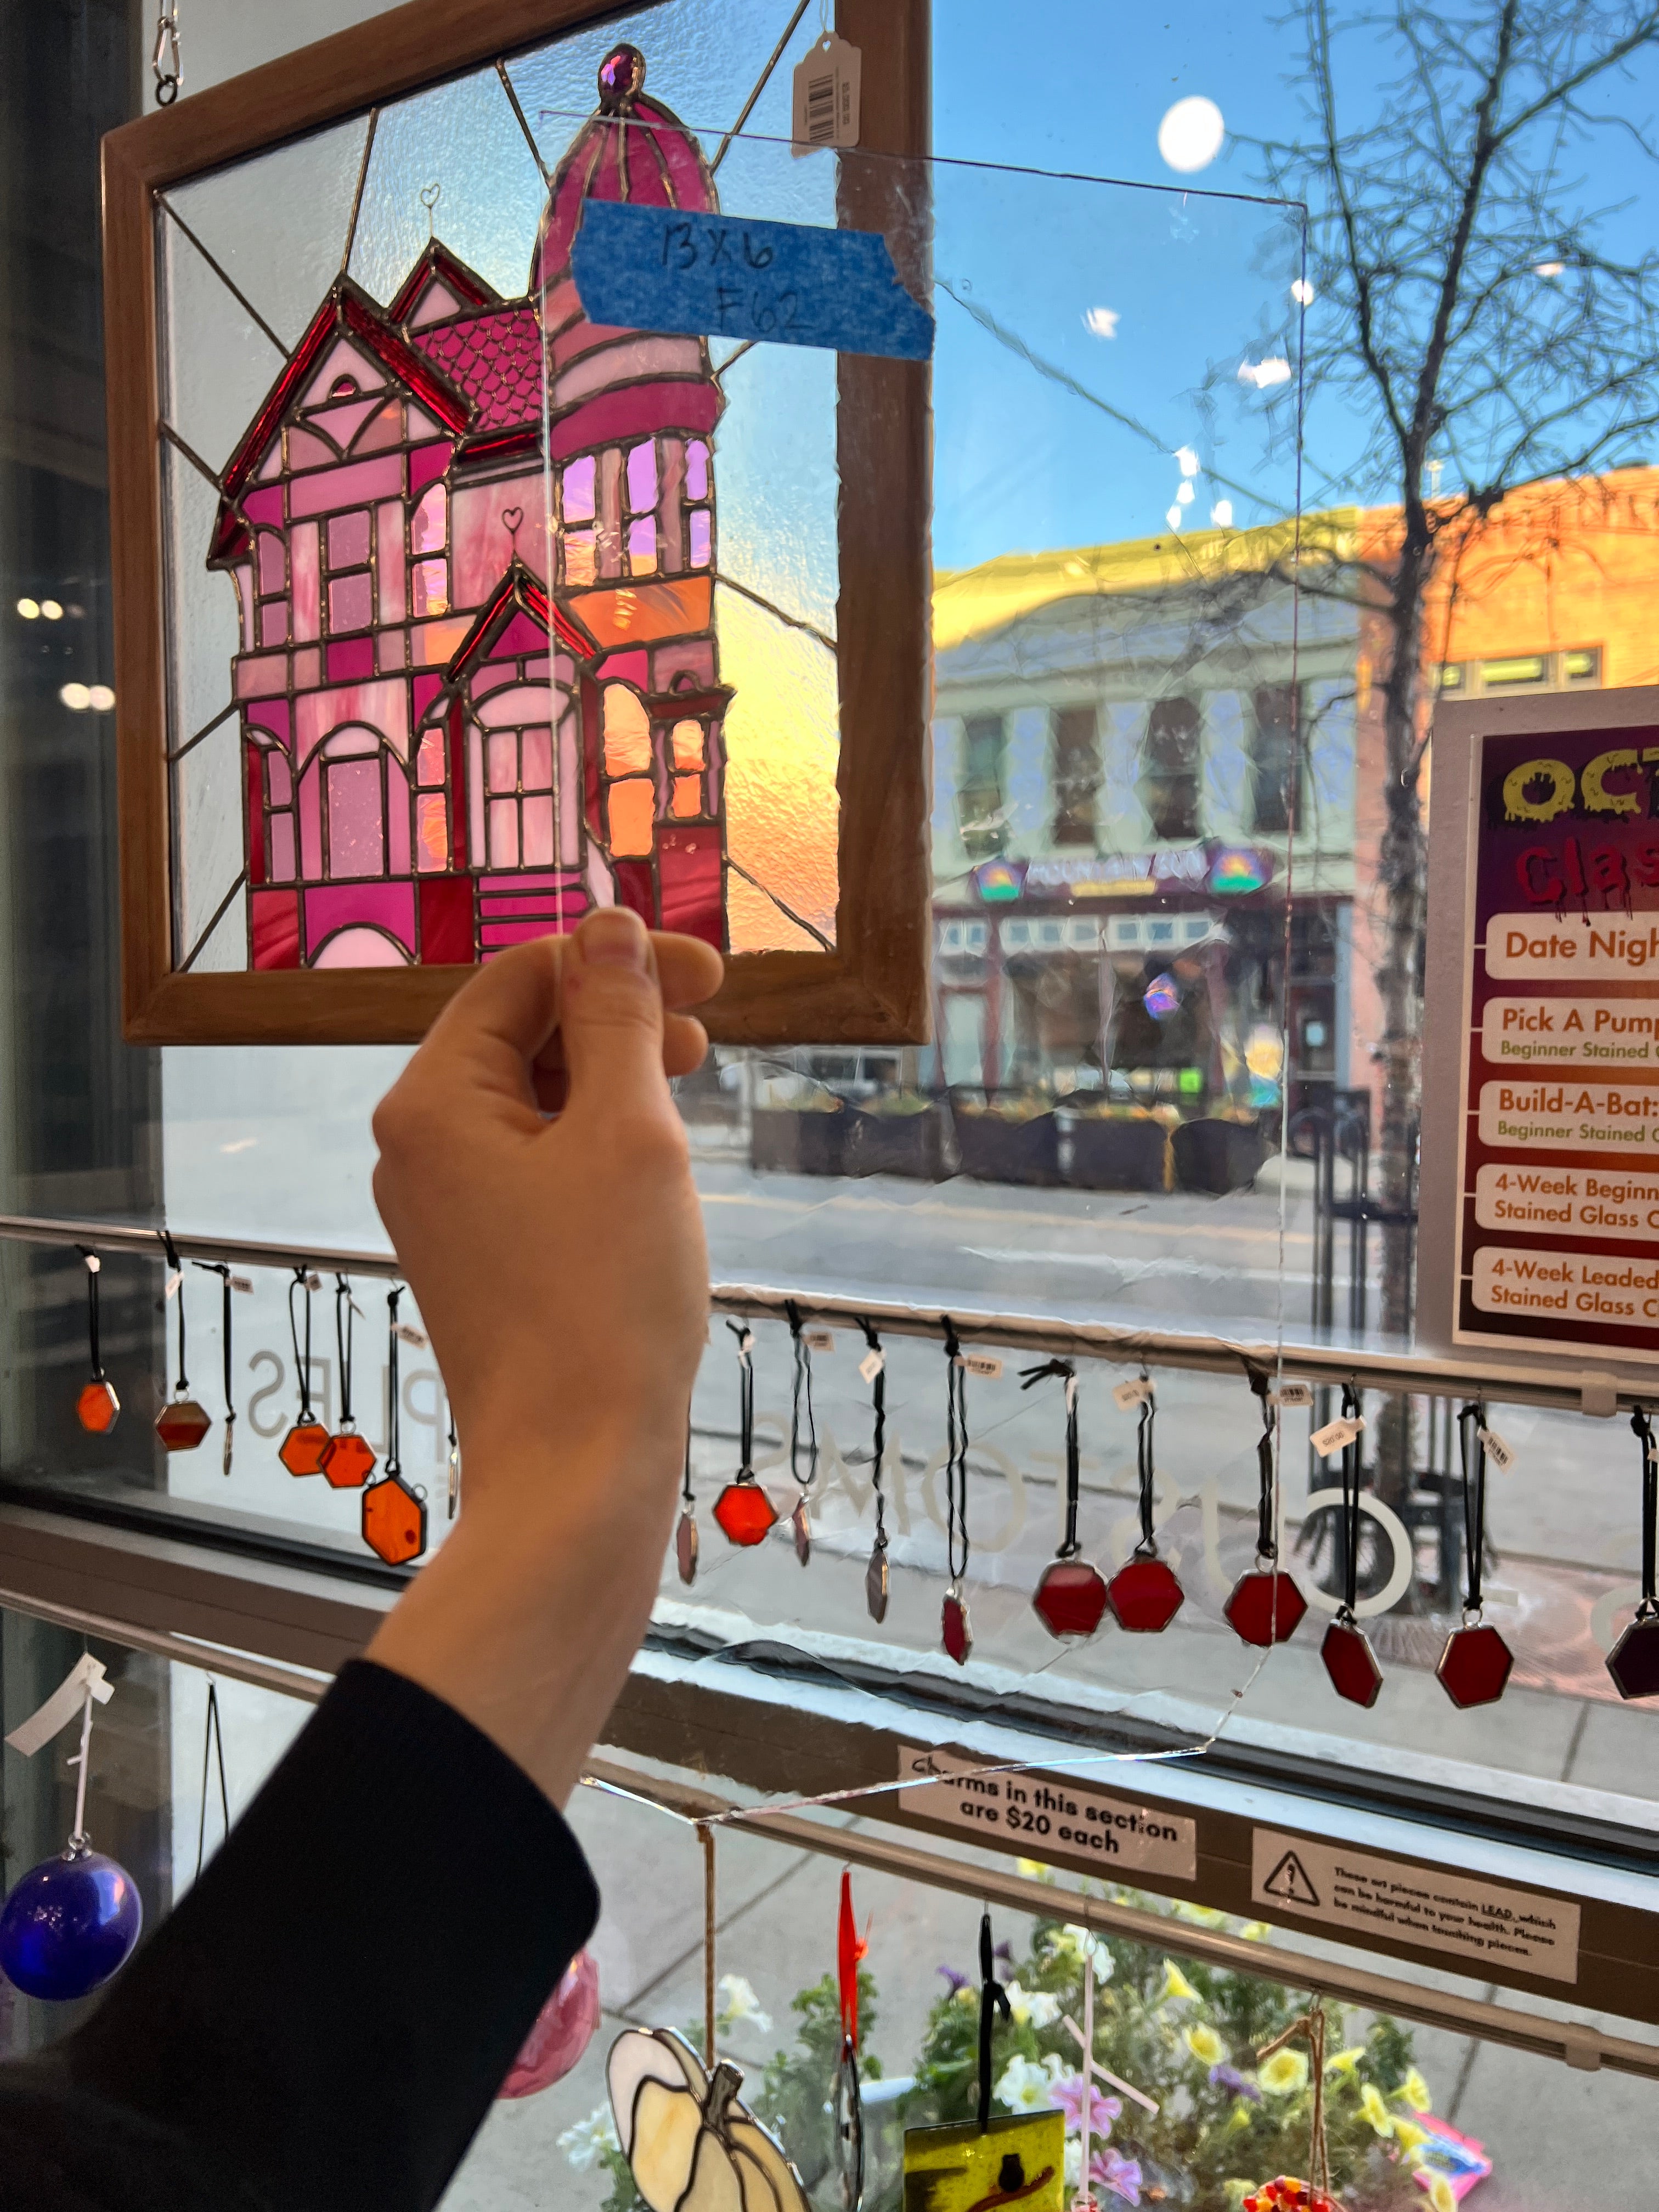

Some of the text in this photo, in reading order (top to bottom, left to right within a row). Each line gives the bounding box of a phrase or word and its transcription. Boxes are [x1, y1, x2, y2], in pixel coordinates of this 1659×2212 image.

[1506, 930, 1577, 959] Date
[1502, 1006, 1554, 1032] Pick
[1564, 1008, 1584, 1032] A
[1500, 1040, 1577, 1060] Beginner
[1583, 1041, 1650, 1058] Stained
[1499, 1087, 1658, 1118] Build-A-Bat:
[1498, 1120, 1573, 1141] Beginner
[1579, 1123, 1646, 1143] Stained
[1494, 1172, 1578, 1196] 4-Week
[1494, 1199, 1572, 1223] Stained
[1579, 1204, 1639, 1227] Glass
[1491, 1257, 1573, 1283] 4-Week
[1491, 1284, 1568, 1310] Stained
[1576, 1291, 1635, 1316] Glass
[1006, 1780, 1026, 1804] in
[1032, 1787, 1077, 1816] this
[1084, 1805, 1178, 1842] section
[959, 1799, 1120, 1854] are $20 each
